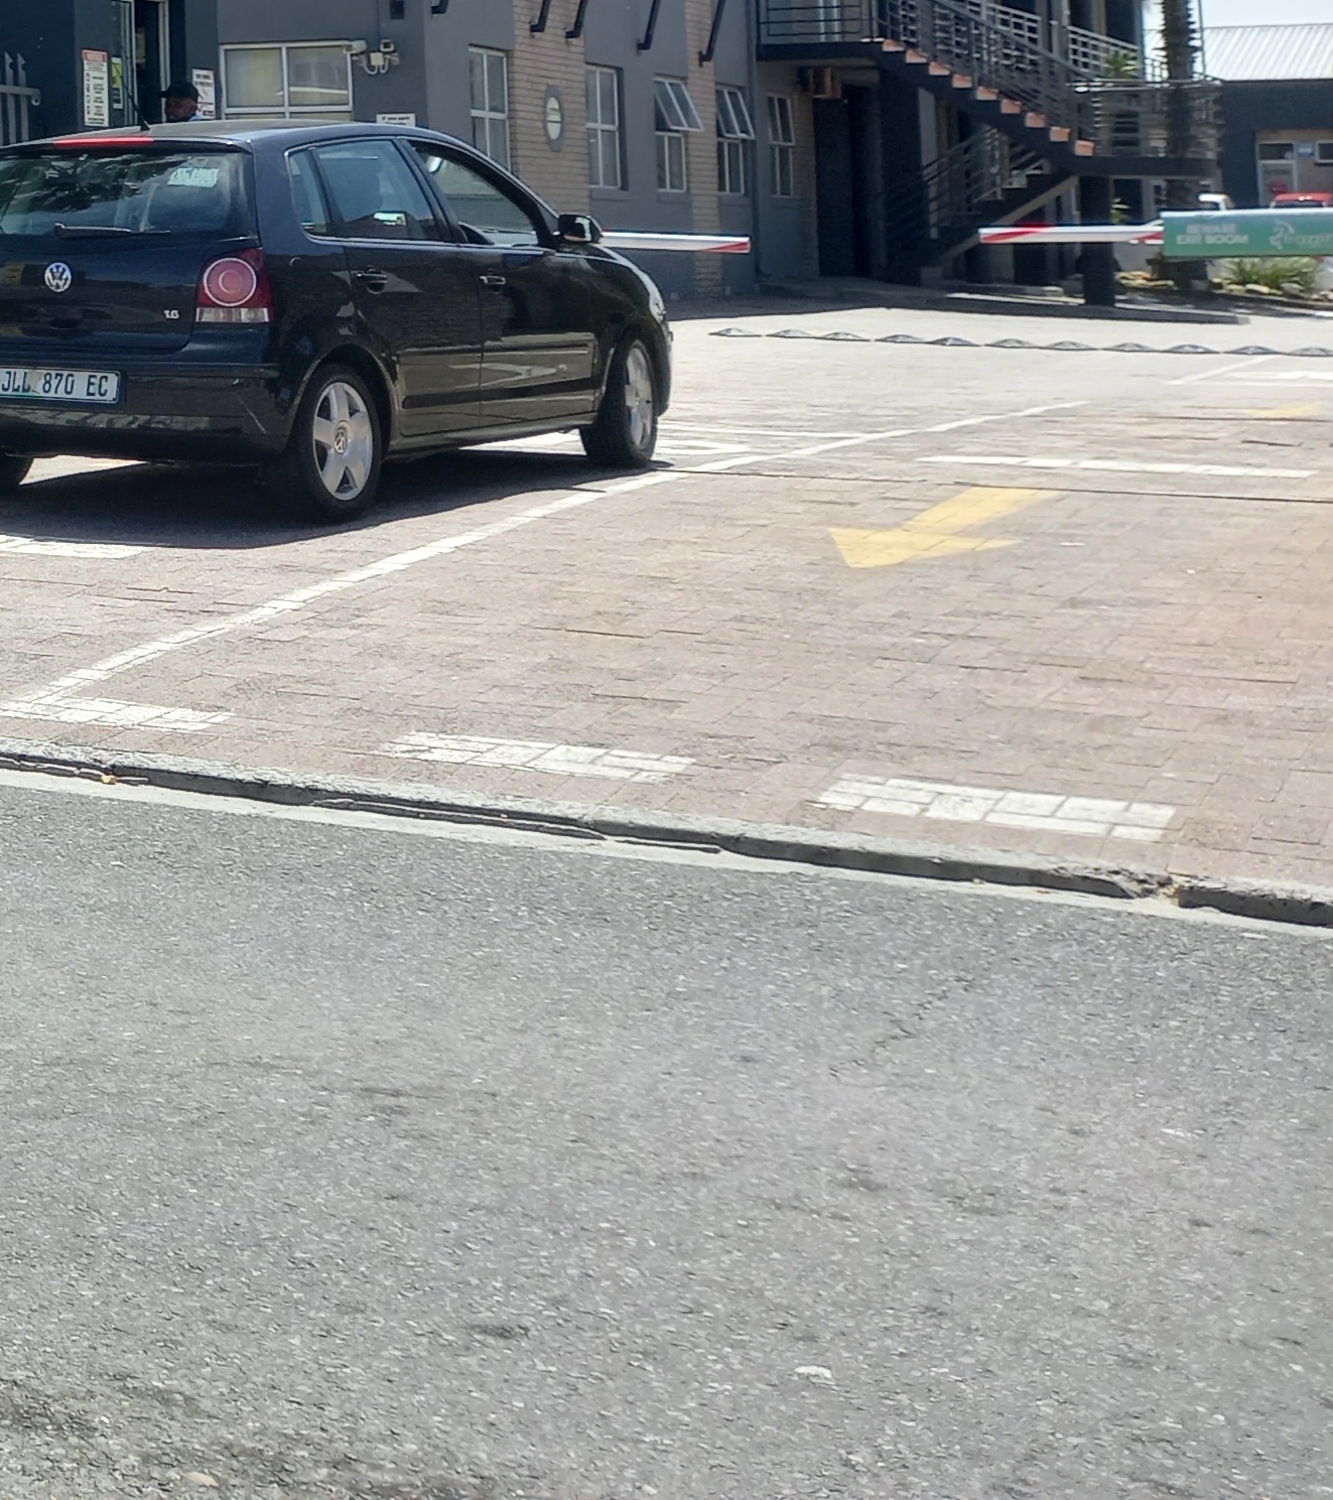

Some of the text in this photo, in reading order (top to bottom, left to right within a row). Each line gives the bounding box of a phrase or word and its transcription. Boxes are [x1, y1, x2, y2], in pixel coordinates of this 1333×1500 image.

[1, 371, 109, 397] JLL 870 EC
